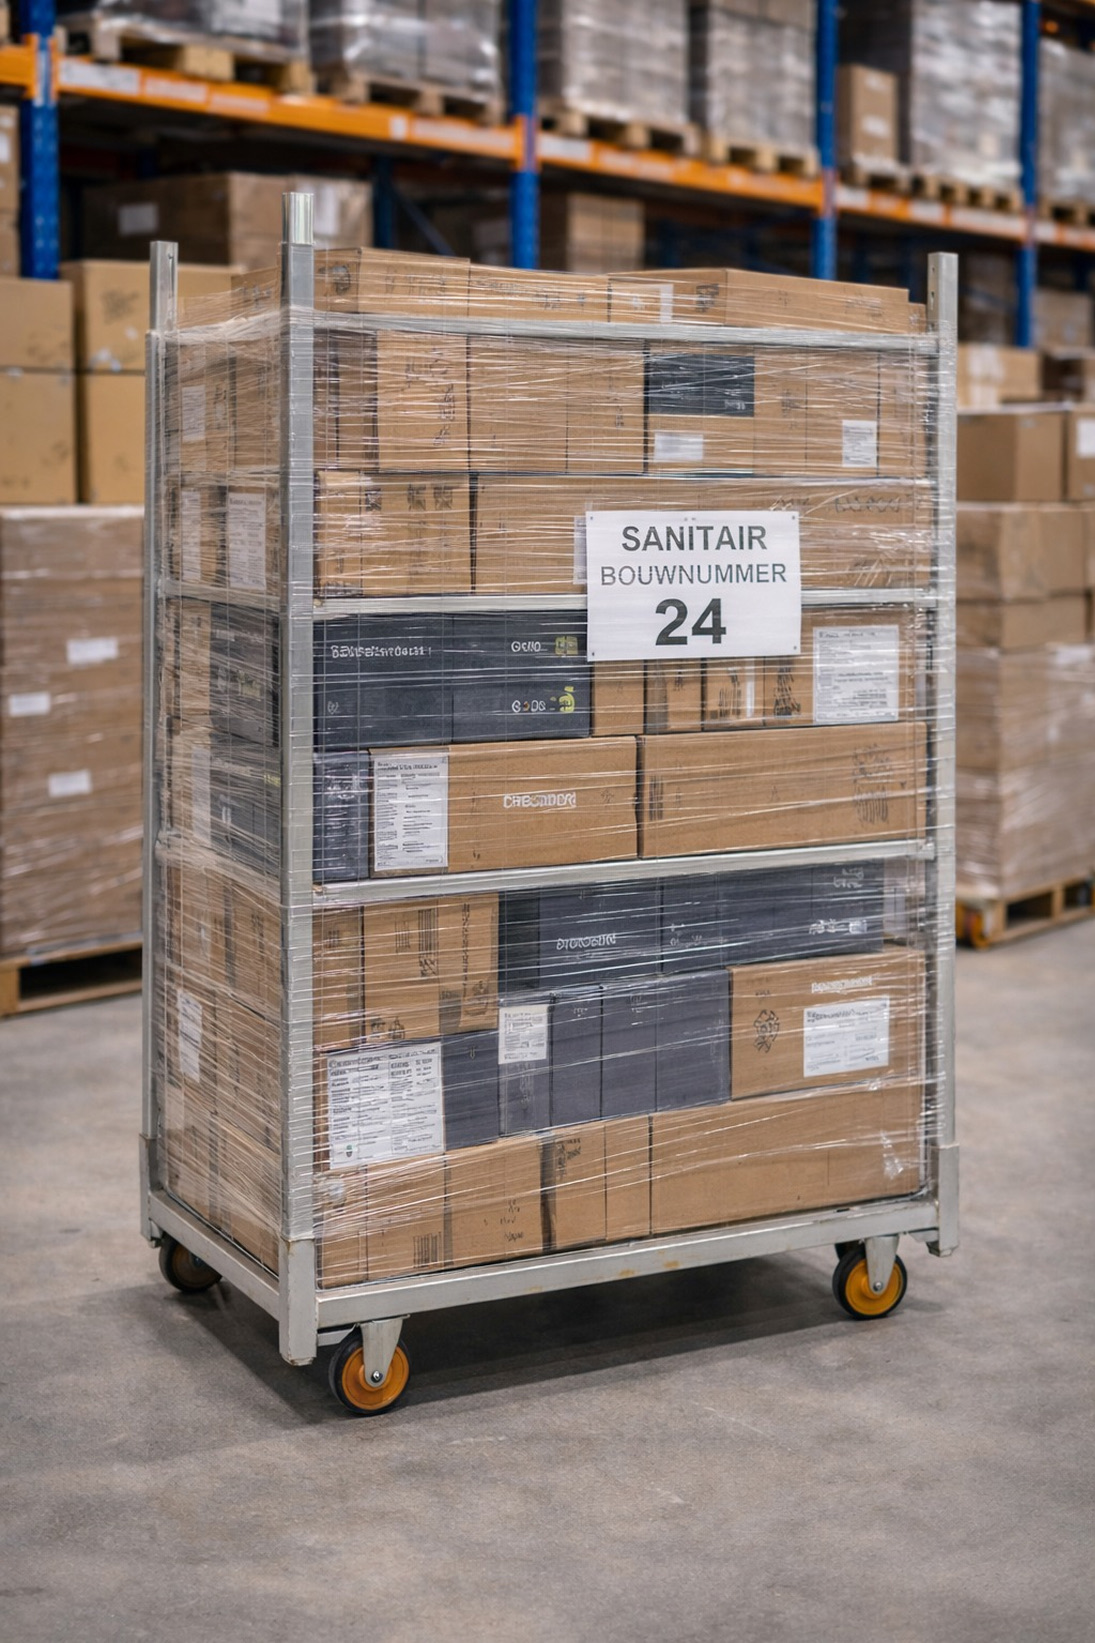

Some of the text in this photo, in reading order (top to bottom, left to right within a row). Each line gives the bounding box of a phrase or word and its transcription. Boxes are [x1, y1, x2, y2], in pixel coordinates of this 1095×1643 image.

[621, 526, 767, 551] SANITAIR
[601, 563, 787, 586] BOUWNUMMER
[655, 598, 727, 646] 24
